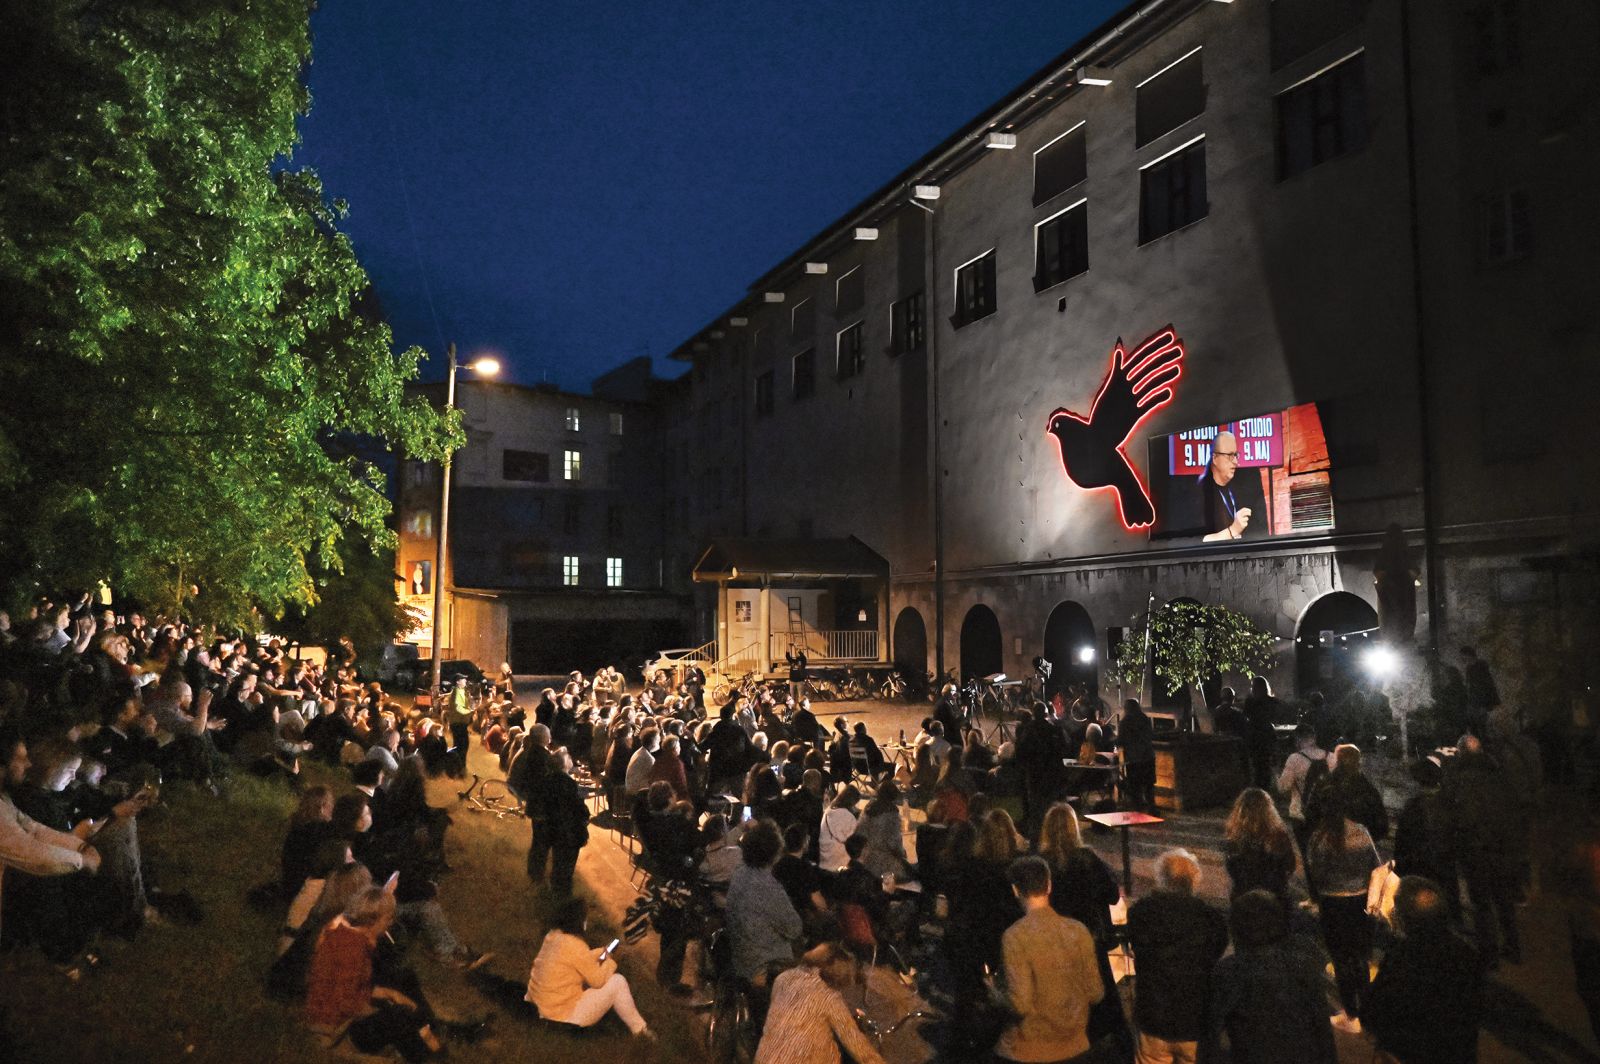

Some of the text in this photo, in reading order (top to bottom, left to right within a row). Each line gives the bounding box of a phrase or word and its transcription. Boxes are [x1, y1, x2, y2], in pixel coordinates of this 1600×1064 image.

[1239, 417, 1273, 438] STUDIO
[1184, 443, 1196, 467] 9.
[1244, 440, 1270, 462] 9. MAJ
